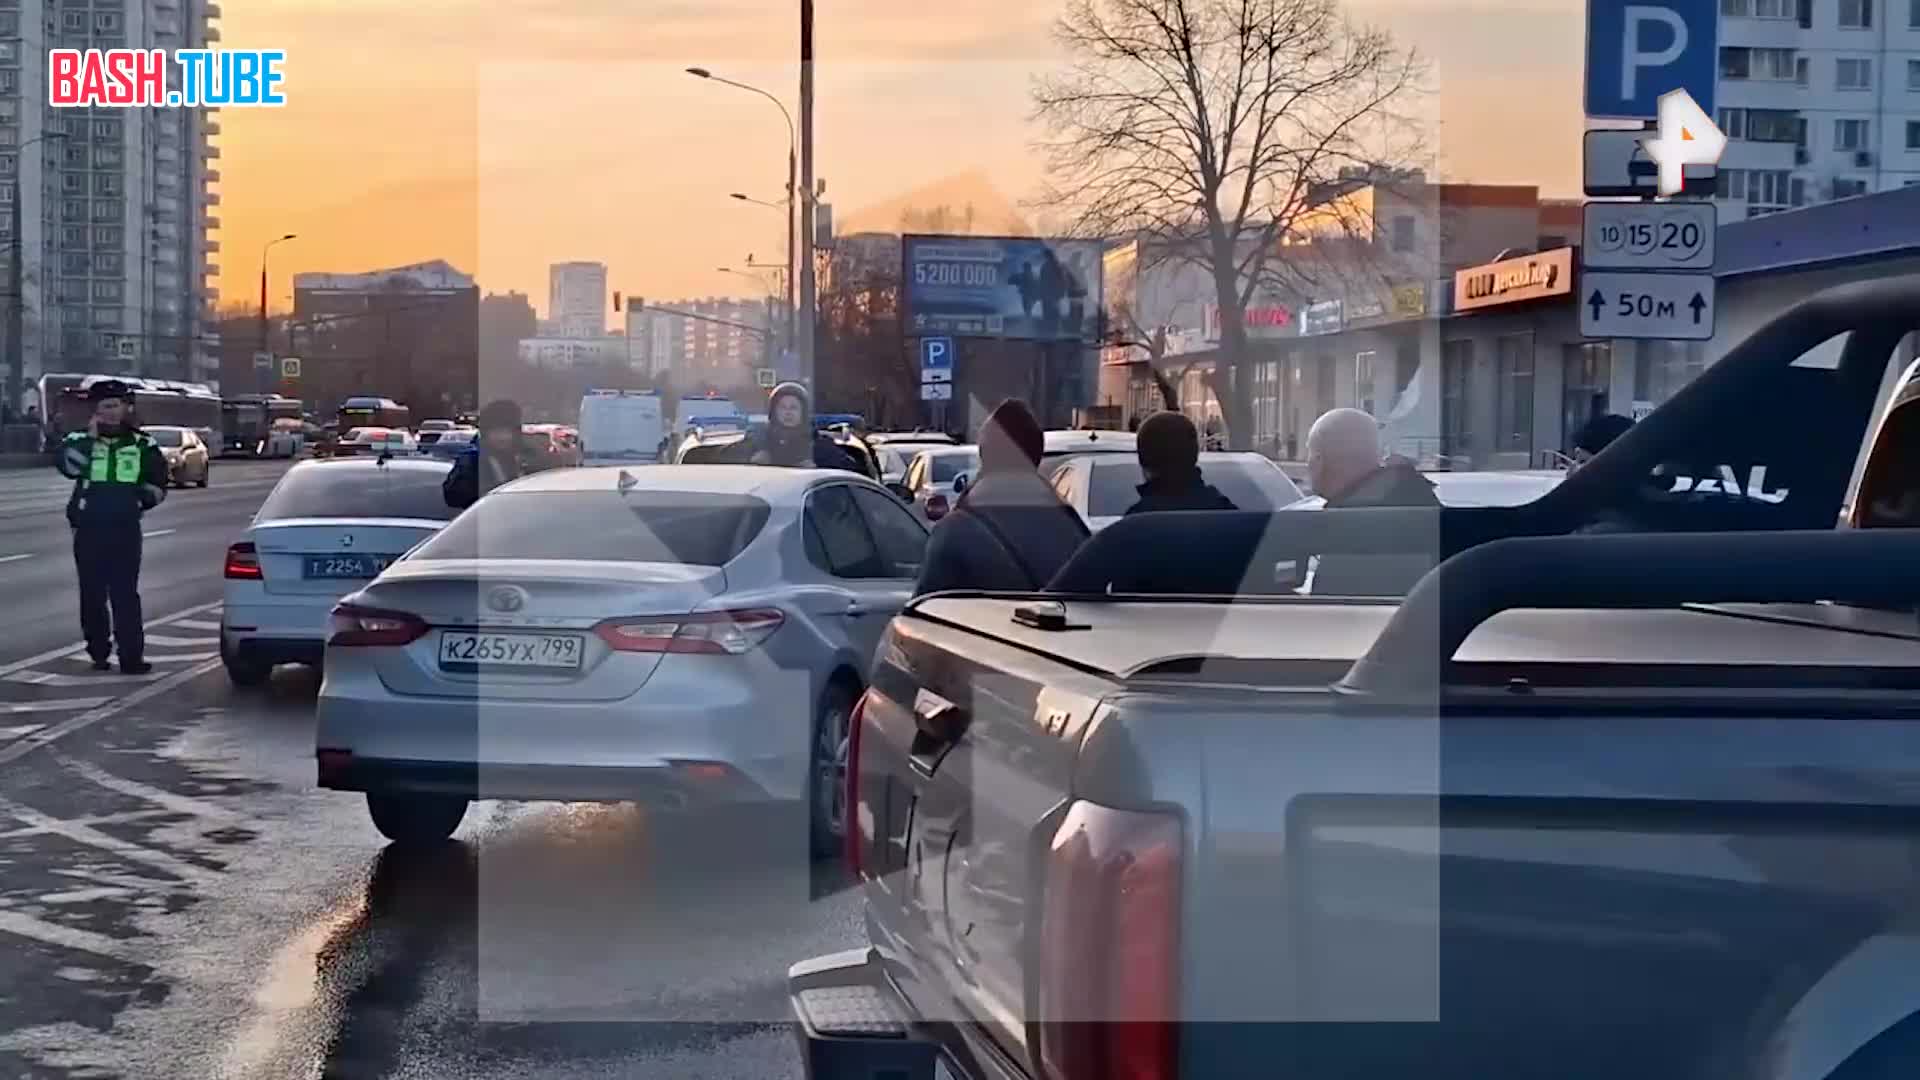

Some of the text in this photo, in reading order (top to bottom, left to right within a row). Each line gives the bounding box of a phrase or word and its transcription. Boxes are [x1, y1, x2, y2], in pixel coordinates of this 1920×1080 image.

[1620, 5, 1689, 100] P
[1601, 222, 1699, 248] 10 15 20
[927, 341, 945, 364] P
[541, 637, 576, 657] 799
